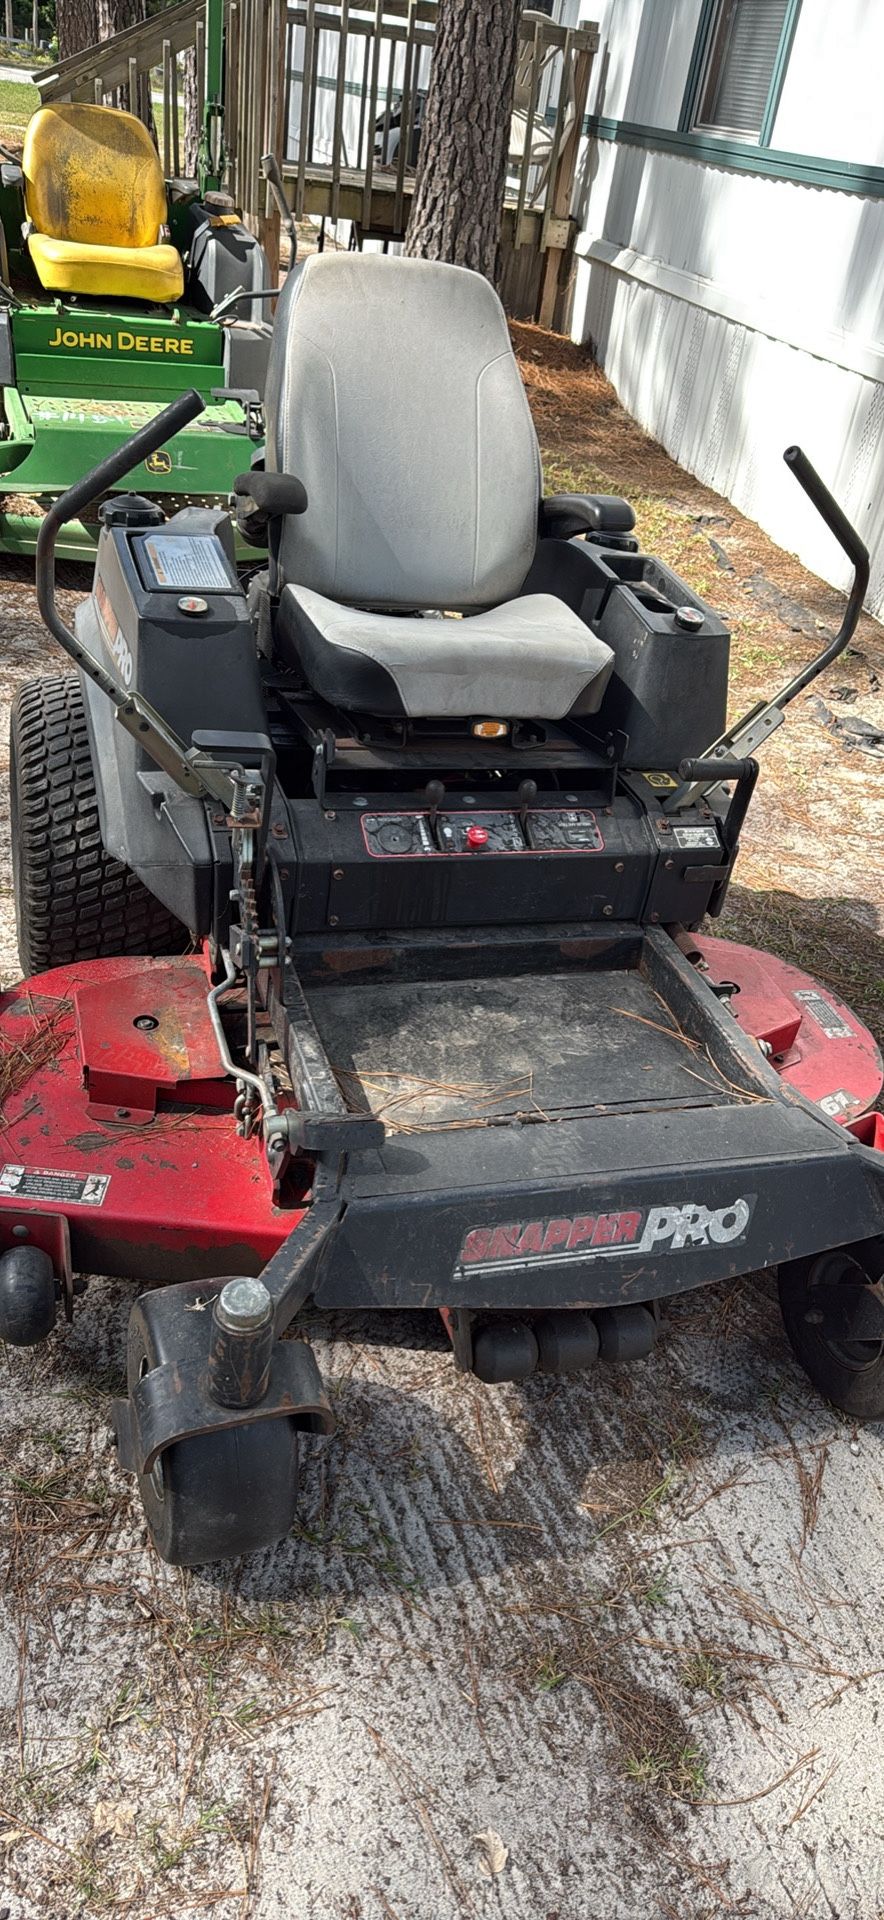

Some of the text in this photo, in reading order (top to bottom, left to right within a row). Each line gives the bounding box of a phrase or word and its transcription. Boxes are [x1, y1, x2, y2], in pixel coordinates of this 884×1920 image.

[49, 328, 194, 355] JOHN DEERE
[113, 627, 133, 685] PRO
[460, 1198, 750, 1262] SNAPPER PRO
